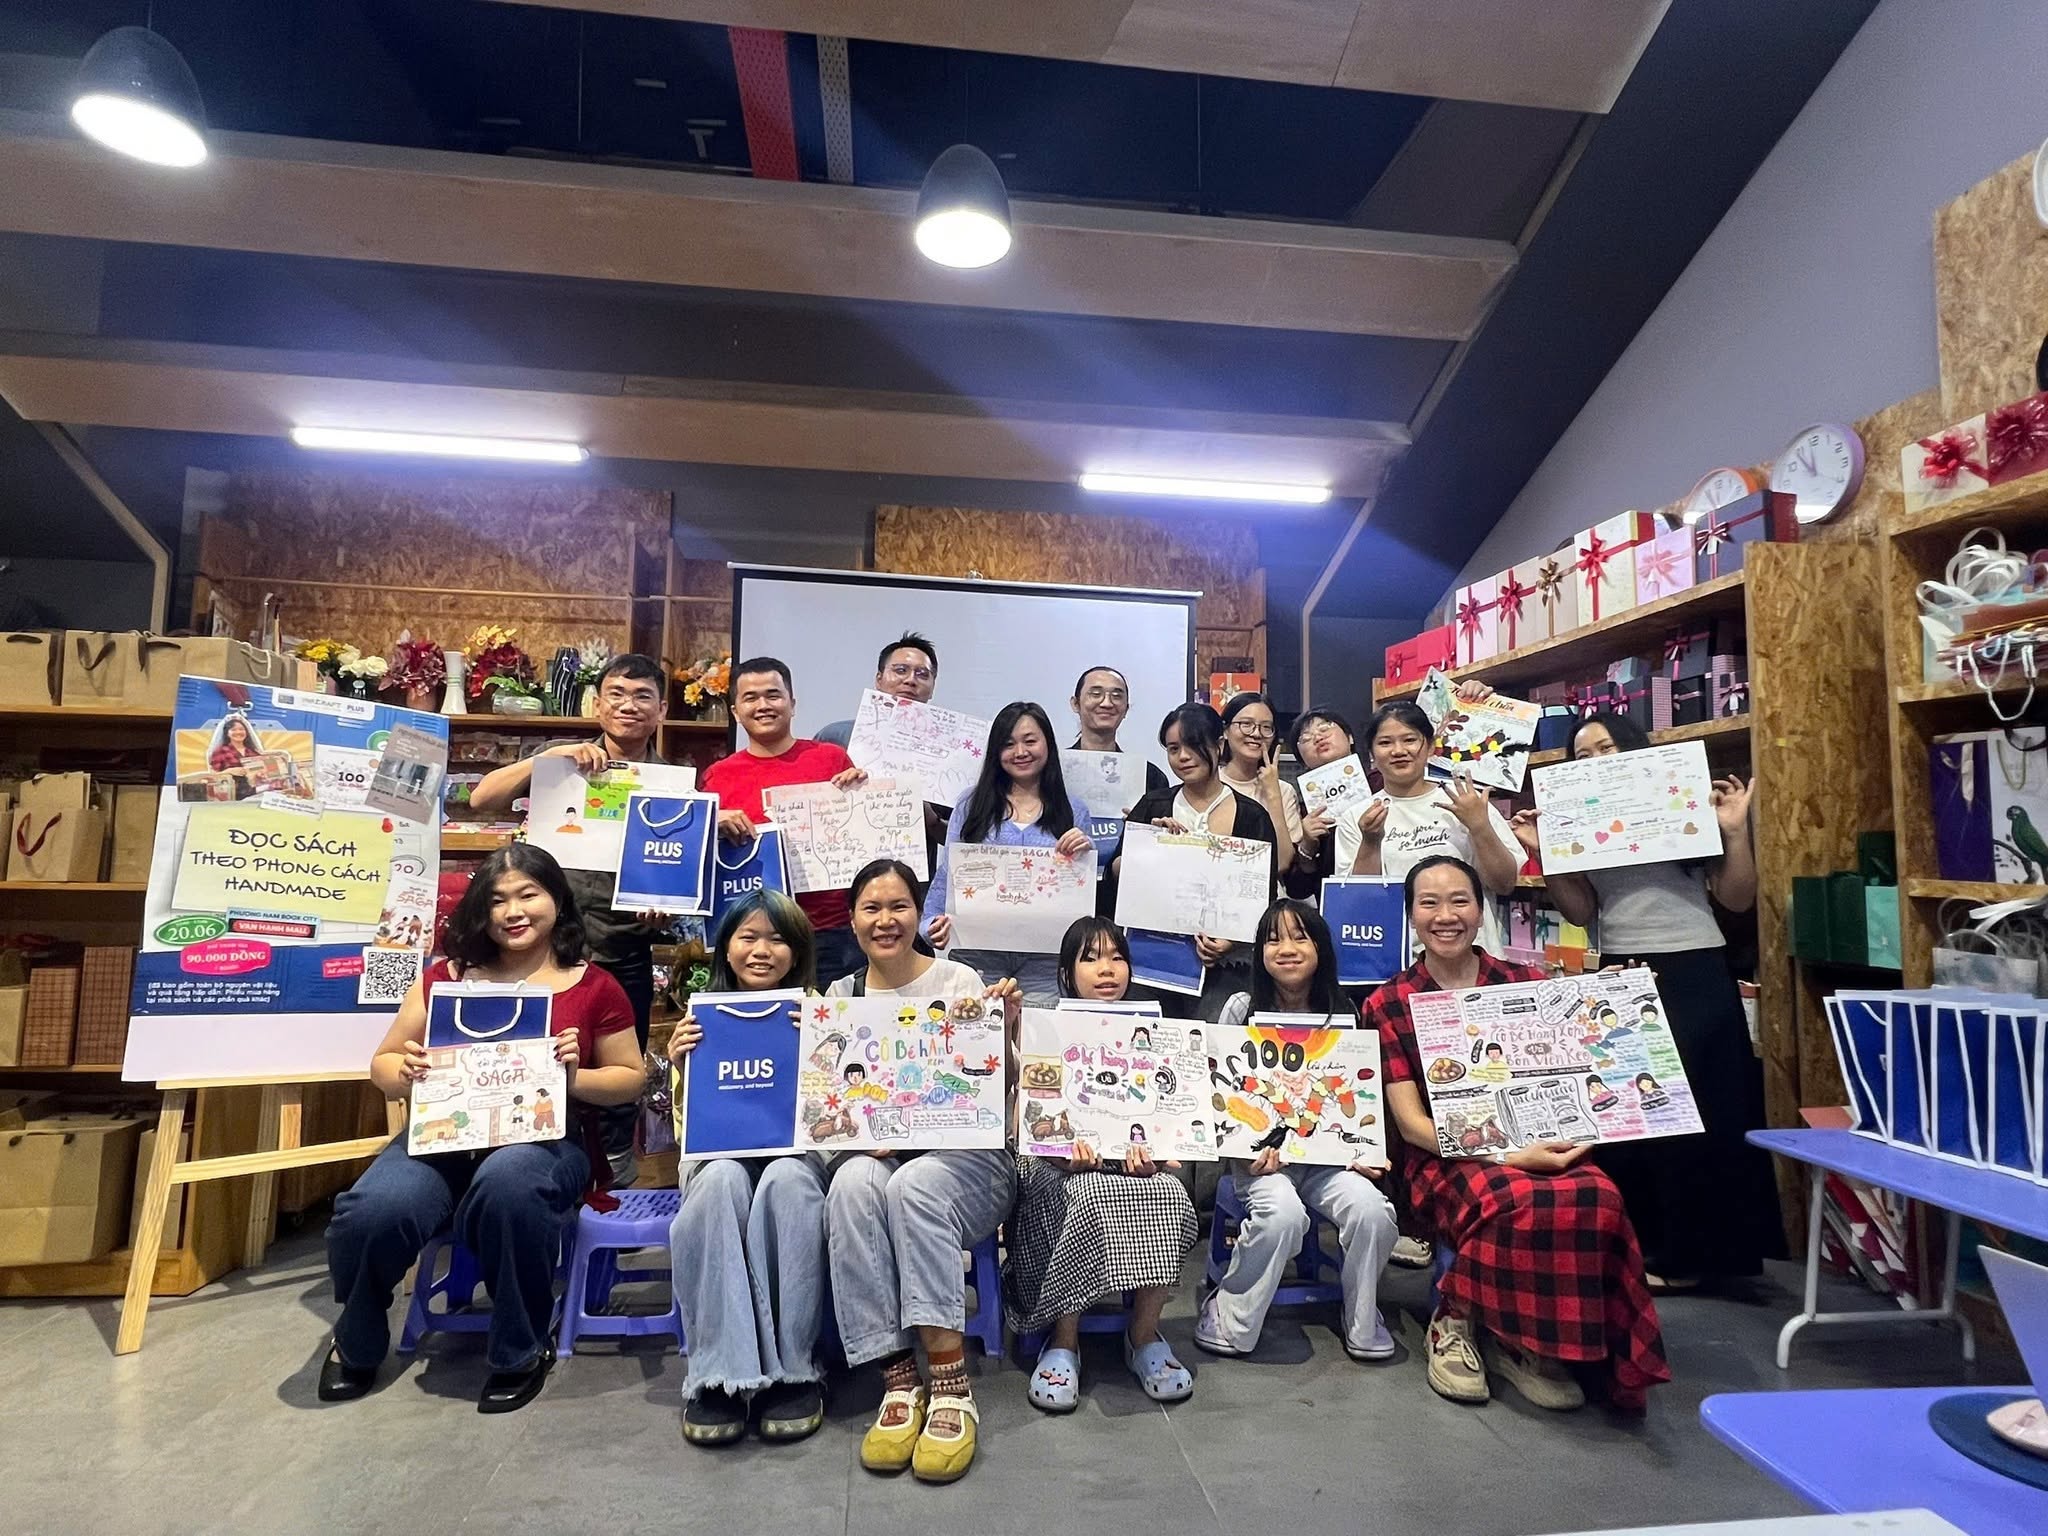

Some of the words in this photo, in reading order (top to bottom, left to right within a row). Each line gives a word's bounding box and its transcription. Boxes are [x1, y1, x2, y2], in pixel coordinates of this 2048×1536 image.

[347, 704, 365, 712] PLUS
[338, 771, 365, 783] 100
[1092, 822, 1118, 836] LUS
[1385, 827, 1411, 842] Love
[1411, 825, 1434, 841] you
[229, 829, 288, 852] ĐỌC
[294, 832, 358, 857] SÁCH
[1398, 840, 1411, 851] so
[1415, 828, 1450, 847] much
[644, 841, 683, 858] PLUS
[1022, 849, 1051, 857] SAGA
[190, 851, 247, 869] THEO
[253, 857, 325, 876] PHONG
[331, 864, 380, 882] CÁCH
[225, 877, 346, 900] HANDMADE
[723, 876, 763, 895] PLUS
[396, 895, 434, 908] SAGA
[168, 922, 216, 942] 20.06
[285, 926, 308, 934] MALL
[1342, 924, 1383, 941] PLUS
[187, 954, 228, 964] 90.000
[230, 950, 266, 962] ĐỒNG
[865, 1036, 891, 1062] CÔ
[1241, 1040, 1305, 1072] 100
[477, 1068, 526, 1087] SAGA
[719, 1058, 774, 1081] PLUS
